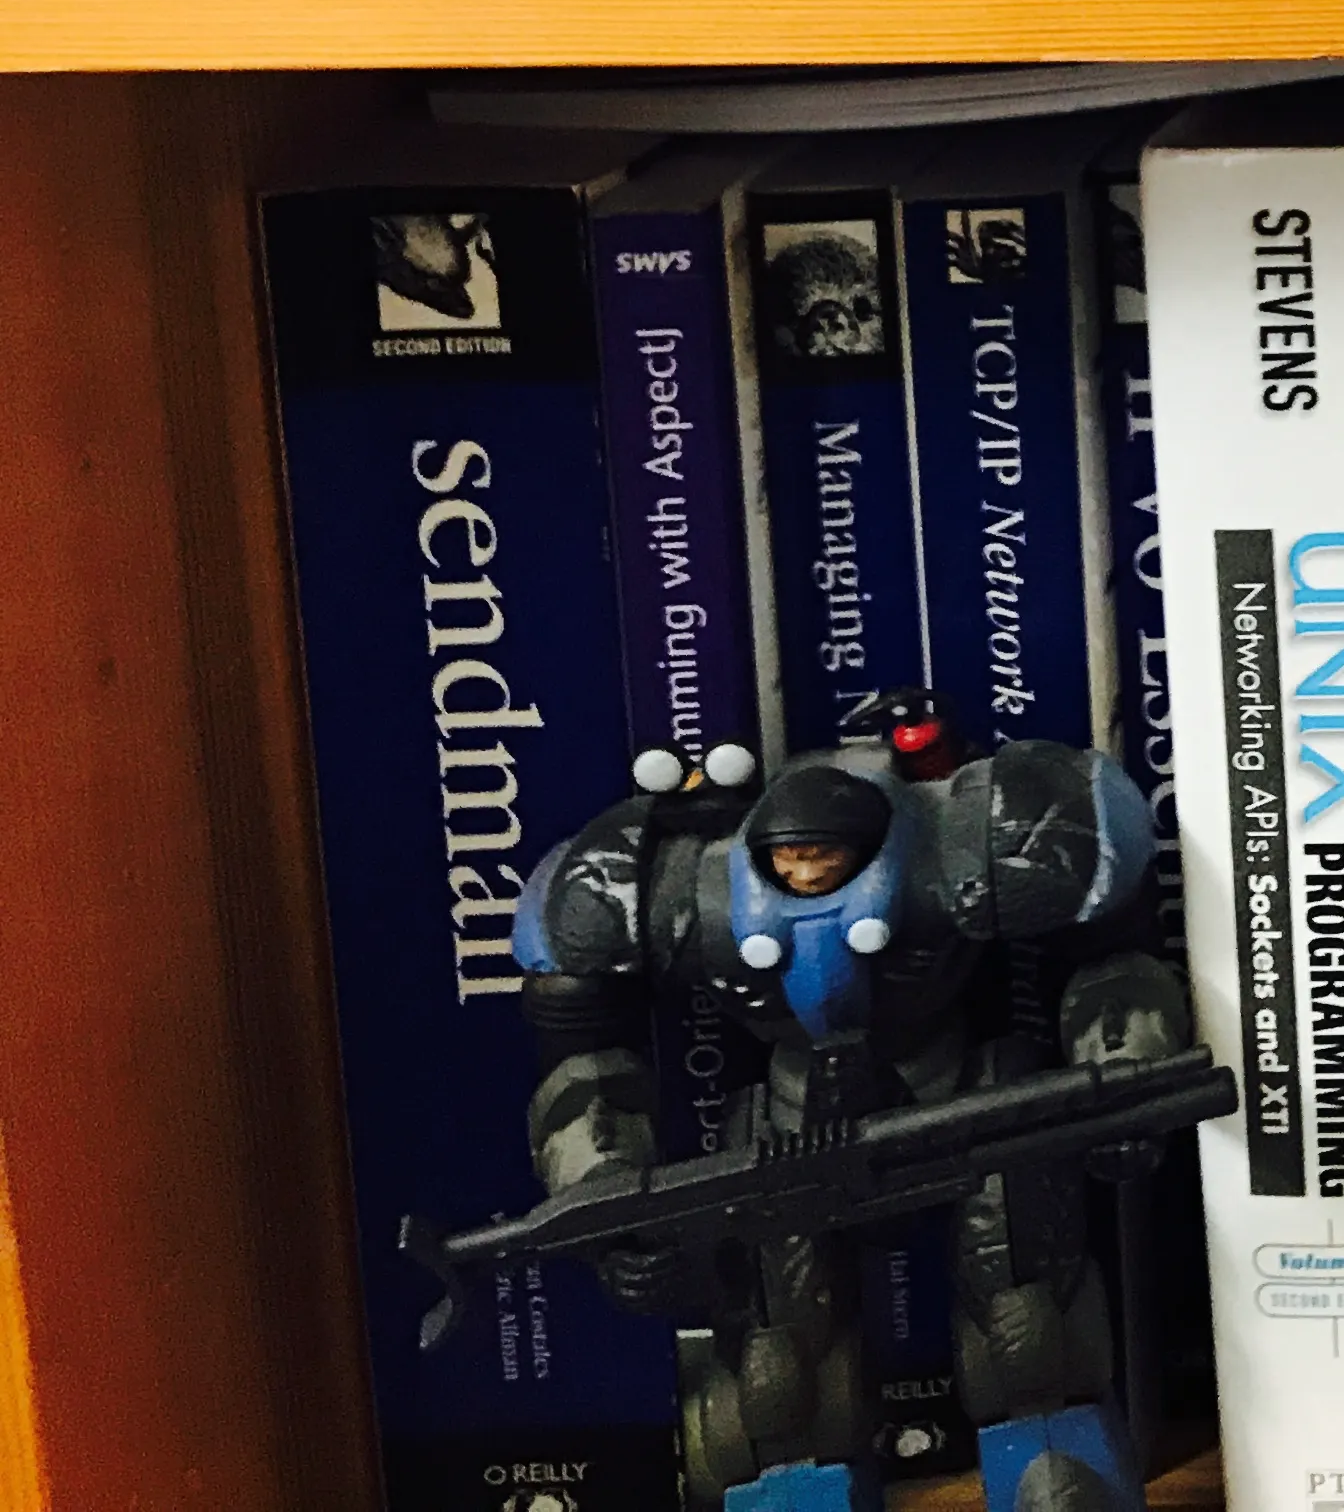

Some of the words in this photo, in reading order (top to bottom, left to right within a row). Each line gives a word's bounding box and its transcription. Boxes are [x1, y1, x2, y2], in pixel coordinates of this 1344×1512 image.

[1254, 208, 1319, 412] STEVENS
[635, 329, 693, 481] AspectJ
[969, 304, 1025, 486] TCP/IP
[646, 497, 687, 588] with
[812, 419, 874, 672] Managing
[979, 501, 1035, 716] Network
[1232, 582, 1276, 772] Networking
[1244, 785, 1278, 863] APIs:
[1245, 873, 1281, 999] Sockets
[1254, 1008, 1288, 1073] and
[1259, 1082, 1288, 1135] XTI
